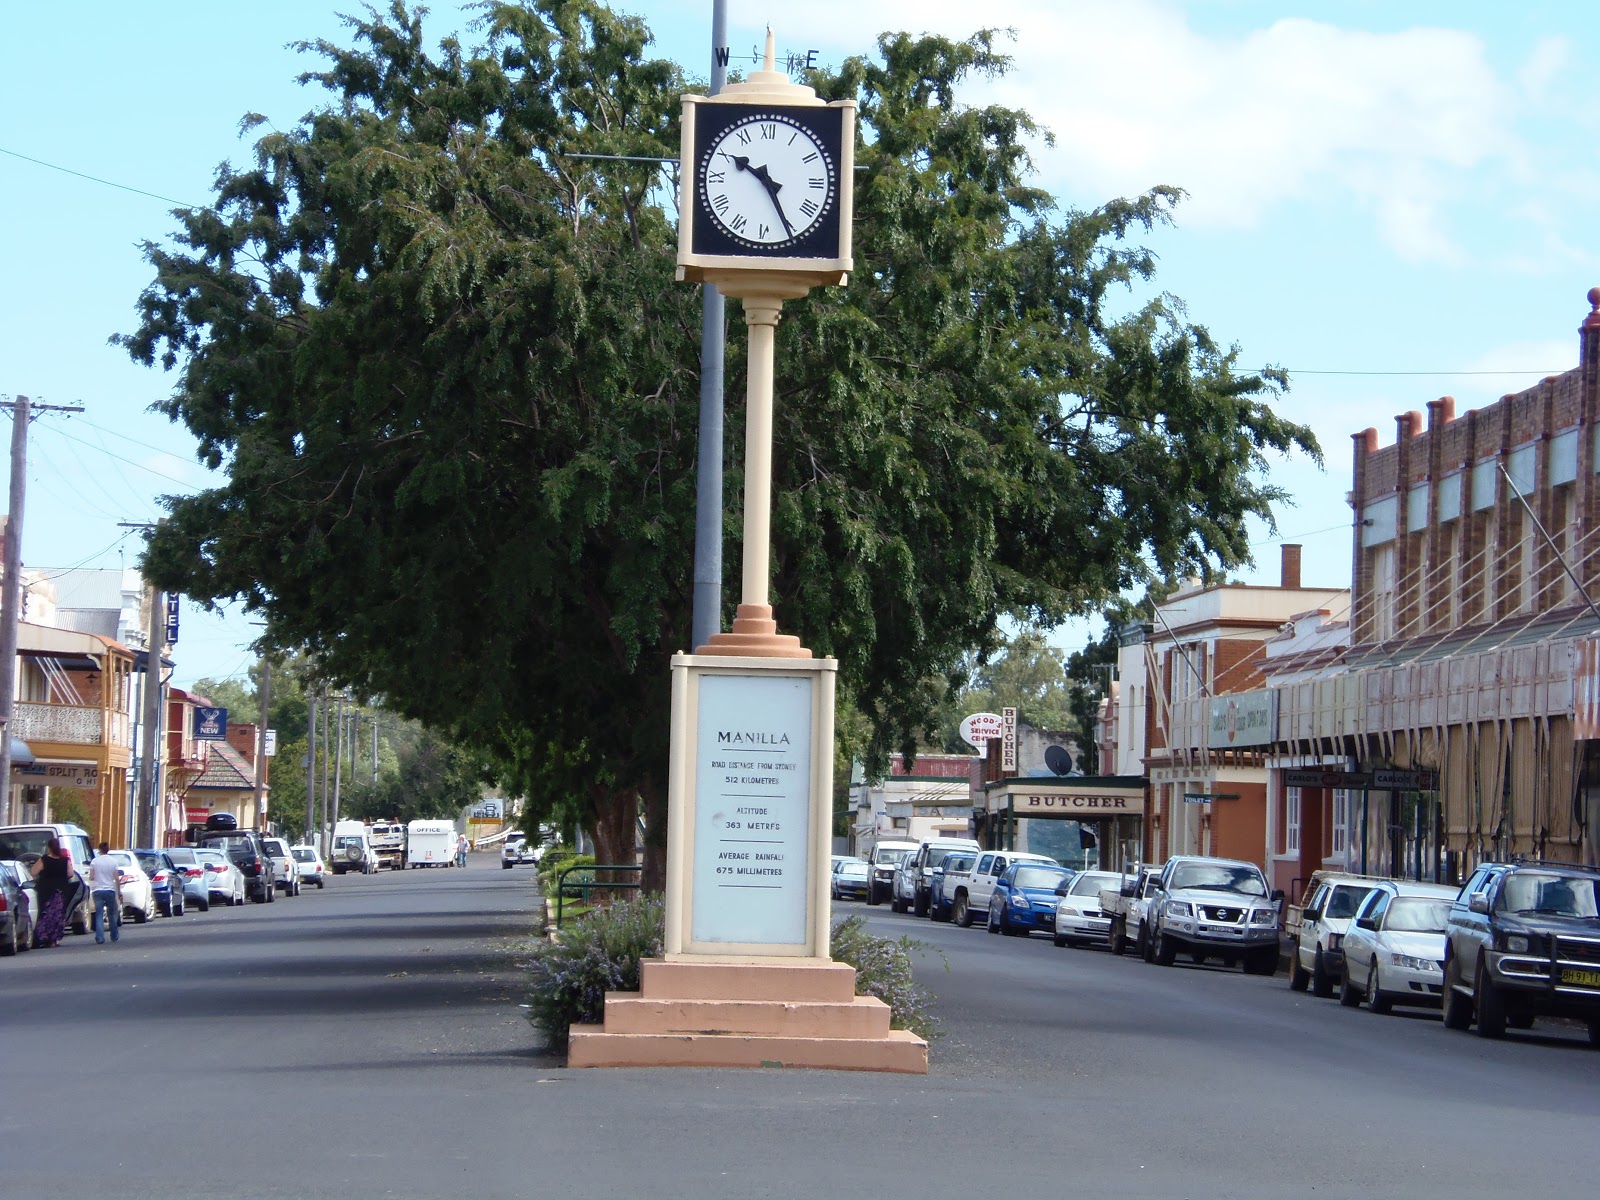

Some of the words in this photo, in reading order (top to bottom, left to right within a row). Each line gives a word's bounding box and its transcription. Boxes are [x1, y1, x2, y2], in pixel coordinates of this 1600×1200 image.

[715, 47, 730, 68] W
[752, 44, 758, 65] S
[805, 50, 819, 70] E
[736, 128, 752, 146] XI
[760, 123, 776, 140] XII
[787, 132, 798, 146] I
[717, 147, 730, 164] X
[802, 152, 819, 164] II
[708, 170, 725, 184] IX
[808, 178, 824, 190] III
[712, 194, 729, 217] VIII
[729, 213, 748, 235] VII
[758, 223, 770, 240] VI
[969, 717, 1002, 729] WOOD'S
[200, 727, 219, 735] NEW
[1003, 709, 1015, 766] BUTCHER
[717, 731, 790, 745] MANILLA
[49, 767, 78, 778] SPLIT
[84, 767, 98, 777] RO
[725, 776, 739, 784] 512
[741, 777, 780, 785] KILOMETRES
[1028, 796, 1127, 808] BUTCHER
[736, 807, 768, 815] ALTITUDE
[725, 821, 741, 829] 363
[747, 822, 780, 830] METRES
[718, 852, 750, 860] AVERAGE
[755, 853, 784, 861] RAINFALL
[736, 868, 782, 876] MILLIMETRES
